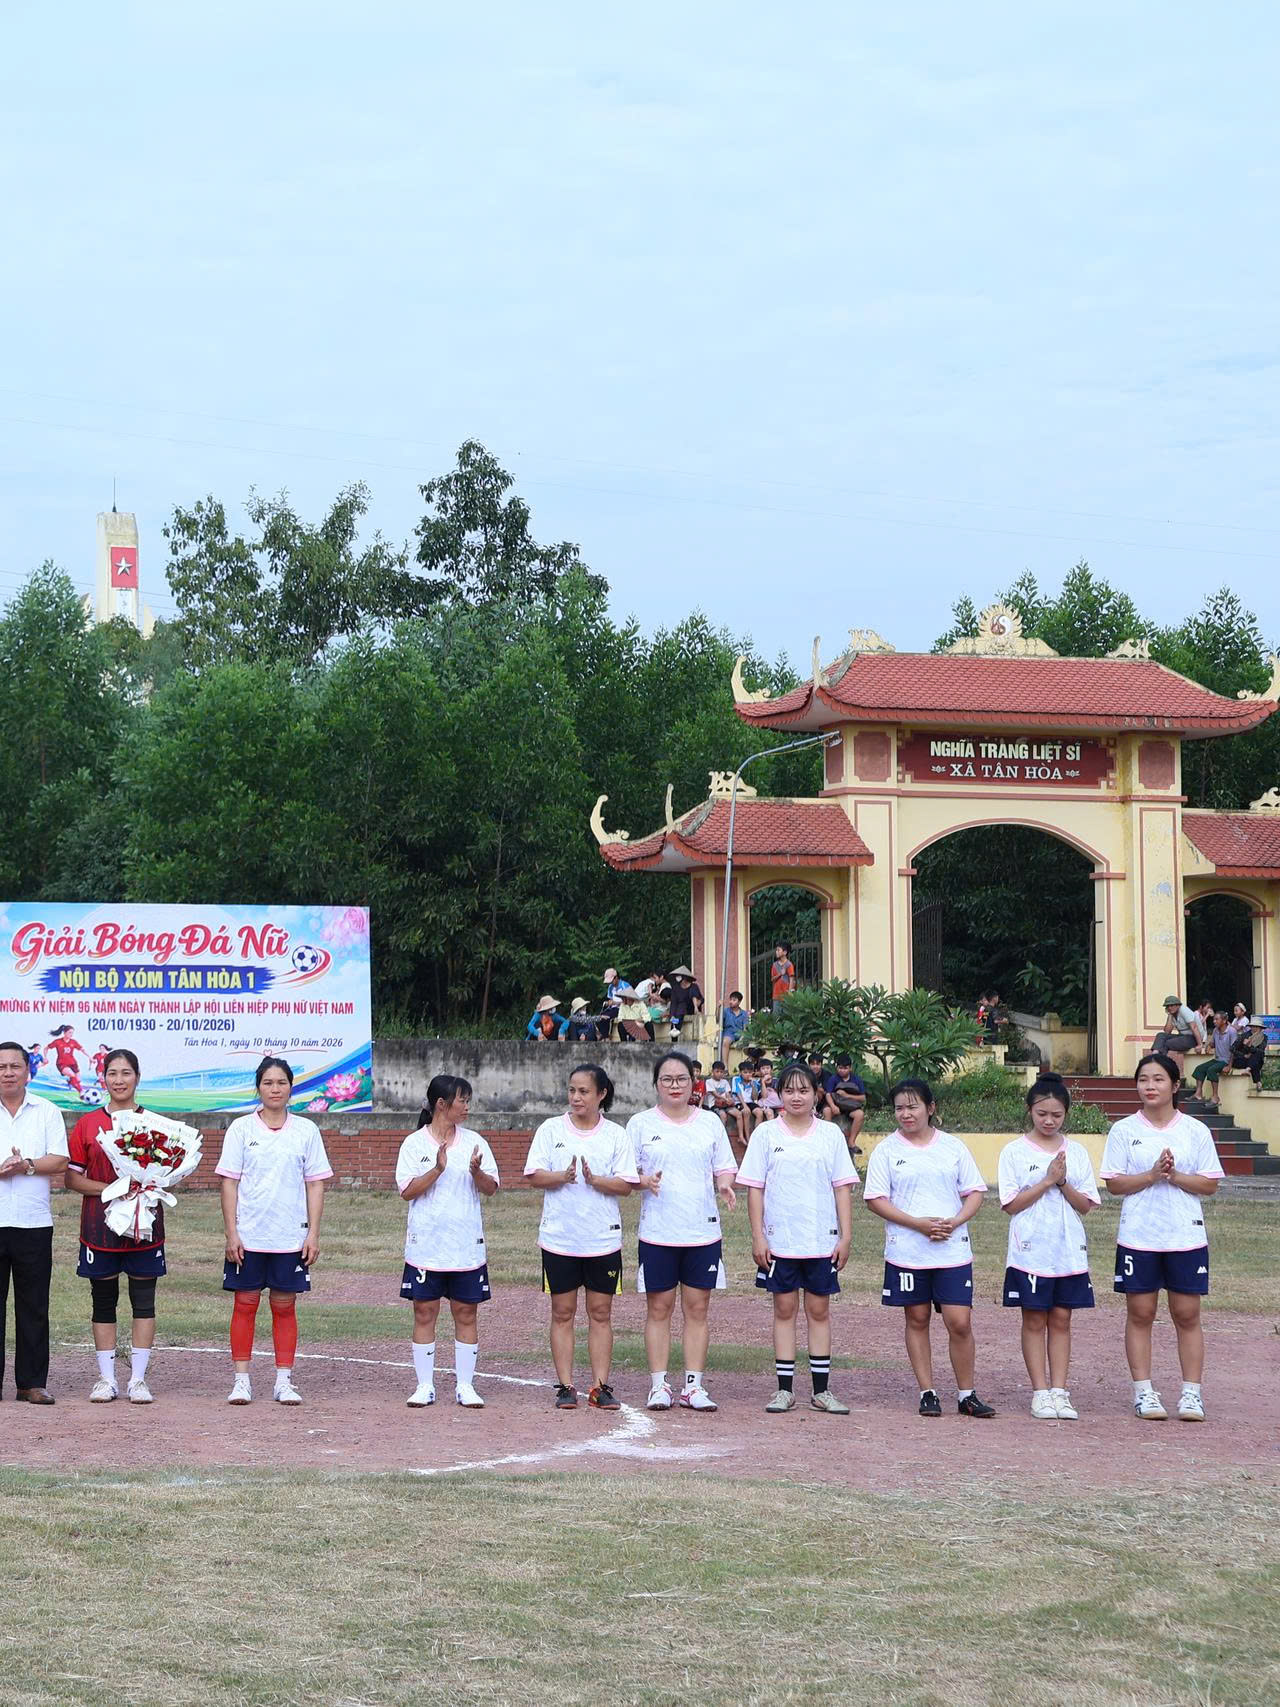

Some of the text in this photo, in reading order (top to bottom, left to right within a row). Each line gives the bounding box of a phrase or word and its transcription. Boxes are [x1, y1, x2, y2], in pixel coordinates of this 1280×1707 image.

[930, 740, 975, 758] NGHĨA
[980, 743, 1029, 760] TRANG
[1033, 743, 1062, 763] LIỆT
[950, 762, 1063, 780] XÃ TÂN HÒA
[12, 922, 289, 974] Giải Bóng Đá Nữ
[60, 967, 255, 991] NỘI BỘ XÓM TÂN HÒA 1
[0, 997, 30, 1013] MỪNG
[49, 997, 75, 1016] NIỆM
[78, 1001, 90, 1013] 96
[93, 999, 116, 1013] NĂM
[119, 999, 145, 1013] NGÀY
[149, 999, 180, 1013] THÀNH
[183, 999, 201, 1016] LẬP
[204, 999, 220, 1016] HỘI
[223, 999, 244, 1014] LIÊN
[247, 999, 269, 1016] HIỆP
[271, 1001, 291, 1016] PHỤ
[293, 999, 308, 1014] NỮ
[309, 1000, 328, 1016] VIỆT
[331, 1002, 354, 1014] NAM
[88, 1018, 156, 1031] (20/10/1930
[166, 1018, 235, 1032] 20/10/2026)
[184, 1037, 199, 1046] Tân
[229, 1038, 251, 1049] ngày
[253, 1038, 263, 1047] 10
[264, 1037, 288, 1049] tháng
[290, 1038, 300, 1047] 10
[301, 1038, 319, 1047] năm
[321, 1038, 344, 1047] 2026
[1124, 1255, 1134, 1276] 5
[899, 1272, 914, 1292] 10
